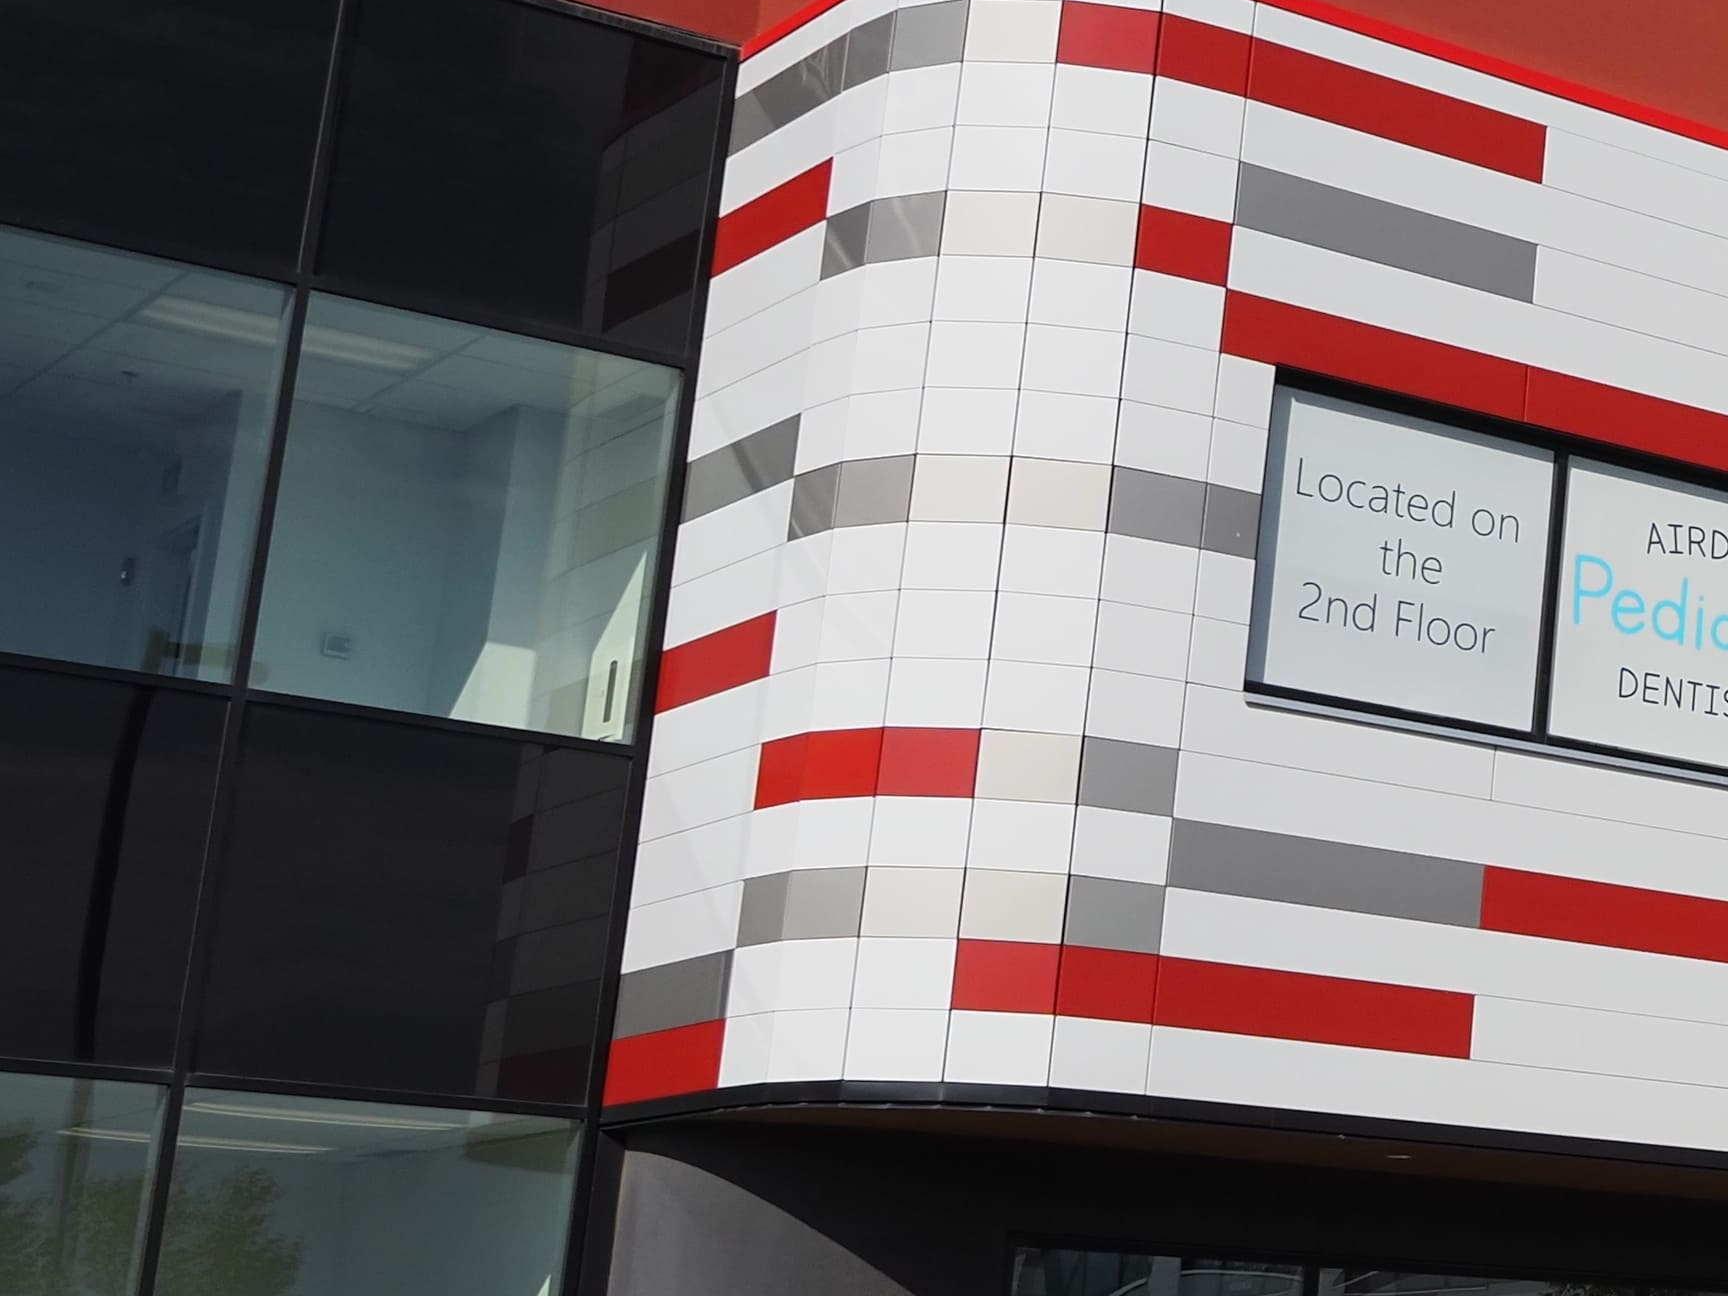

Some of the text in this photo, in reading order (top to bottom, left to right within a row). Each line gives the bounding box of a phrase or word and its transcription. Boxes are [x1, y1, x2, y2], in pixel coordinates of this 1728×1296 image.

[1294, 456, 1521, 543] Located on
[1379, 537, 1443, 586] the
[1297, 582, 1496, 655] 2nd Floor
